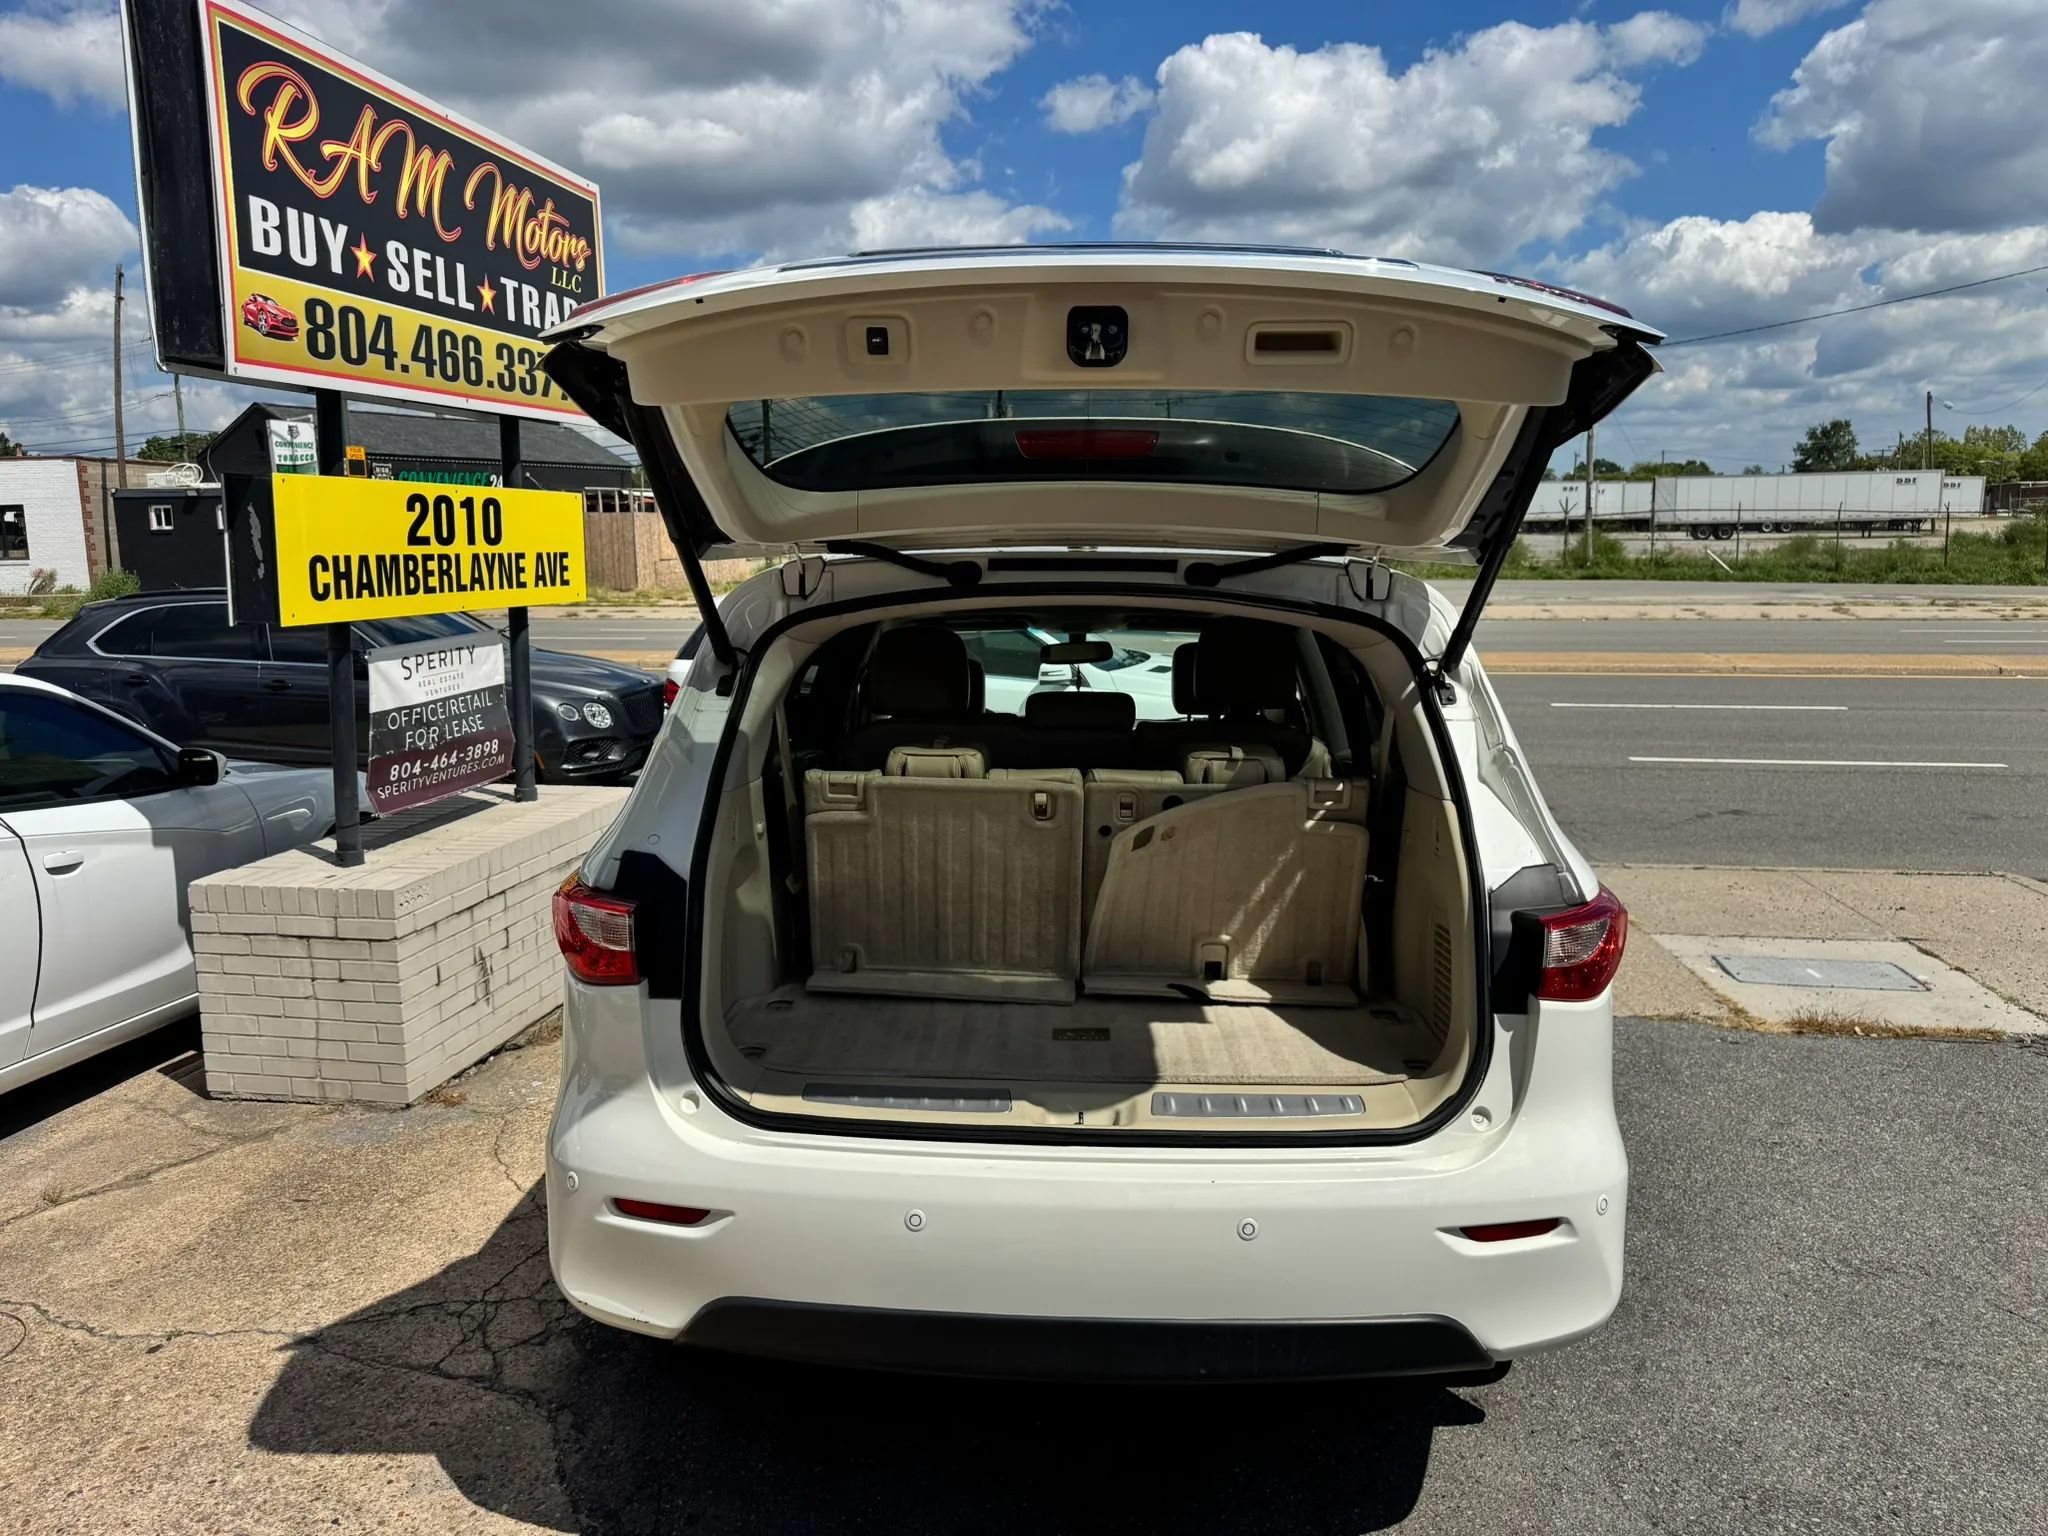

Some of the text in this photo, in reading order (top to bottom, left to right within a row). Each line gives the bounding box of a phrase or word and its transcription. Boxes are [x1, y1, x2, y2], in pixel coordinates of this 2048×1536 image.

[237, 61, 592, 272] RAM Motors
[248, 194, 587, 331] BUY SELL TRAD
[551, 266, 582, 293] LLC
[277, 453, 315, 462] TOBACCO
[399, 470, 503, 488] CONVENIENCE 24
[1896, 477, 1917, 485] DDI
[406, 493, 502, 547] 2010
[309, 552, 570, 602] CHAMBERLAYNE AVE
[400, 644, 476, 680] SPERITY
[418, 672, 464, 688] REAL ESTATE
[425, 683, 460, 697] VENTURES
[387, 691, 493, 730] OFFICE/RETAIL
[405, 714, 485, 751] FOR LEASE
[377, 753, 505, 800] SPERITYVENTURES.COM
[390, 738, 499, 781] 804-464-3898
